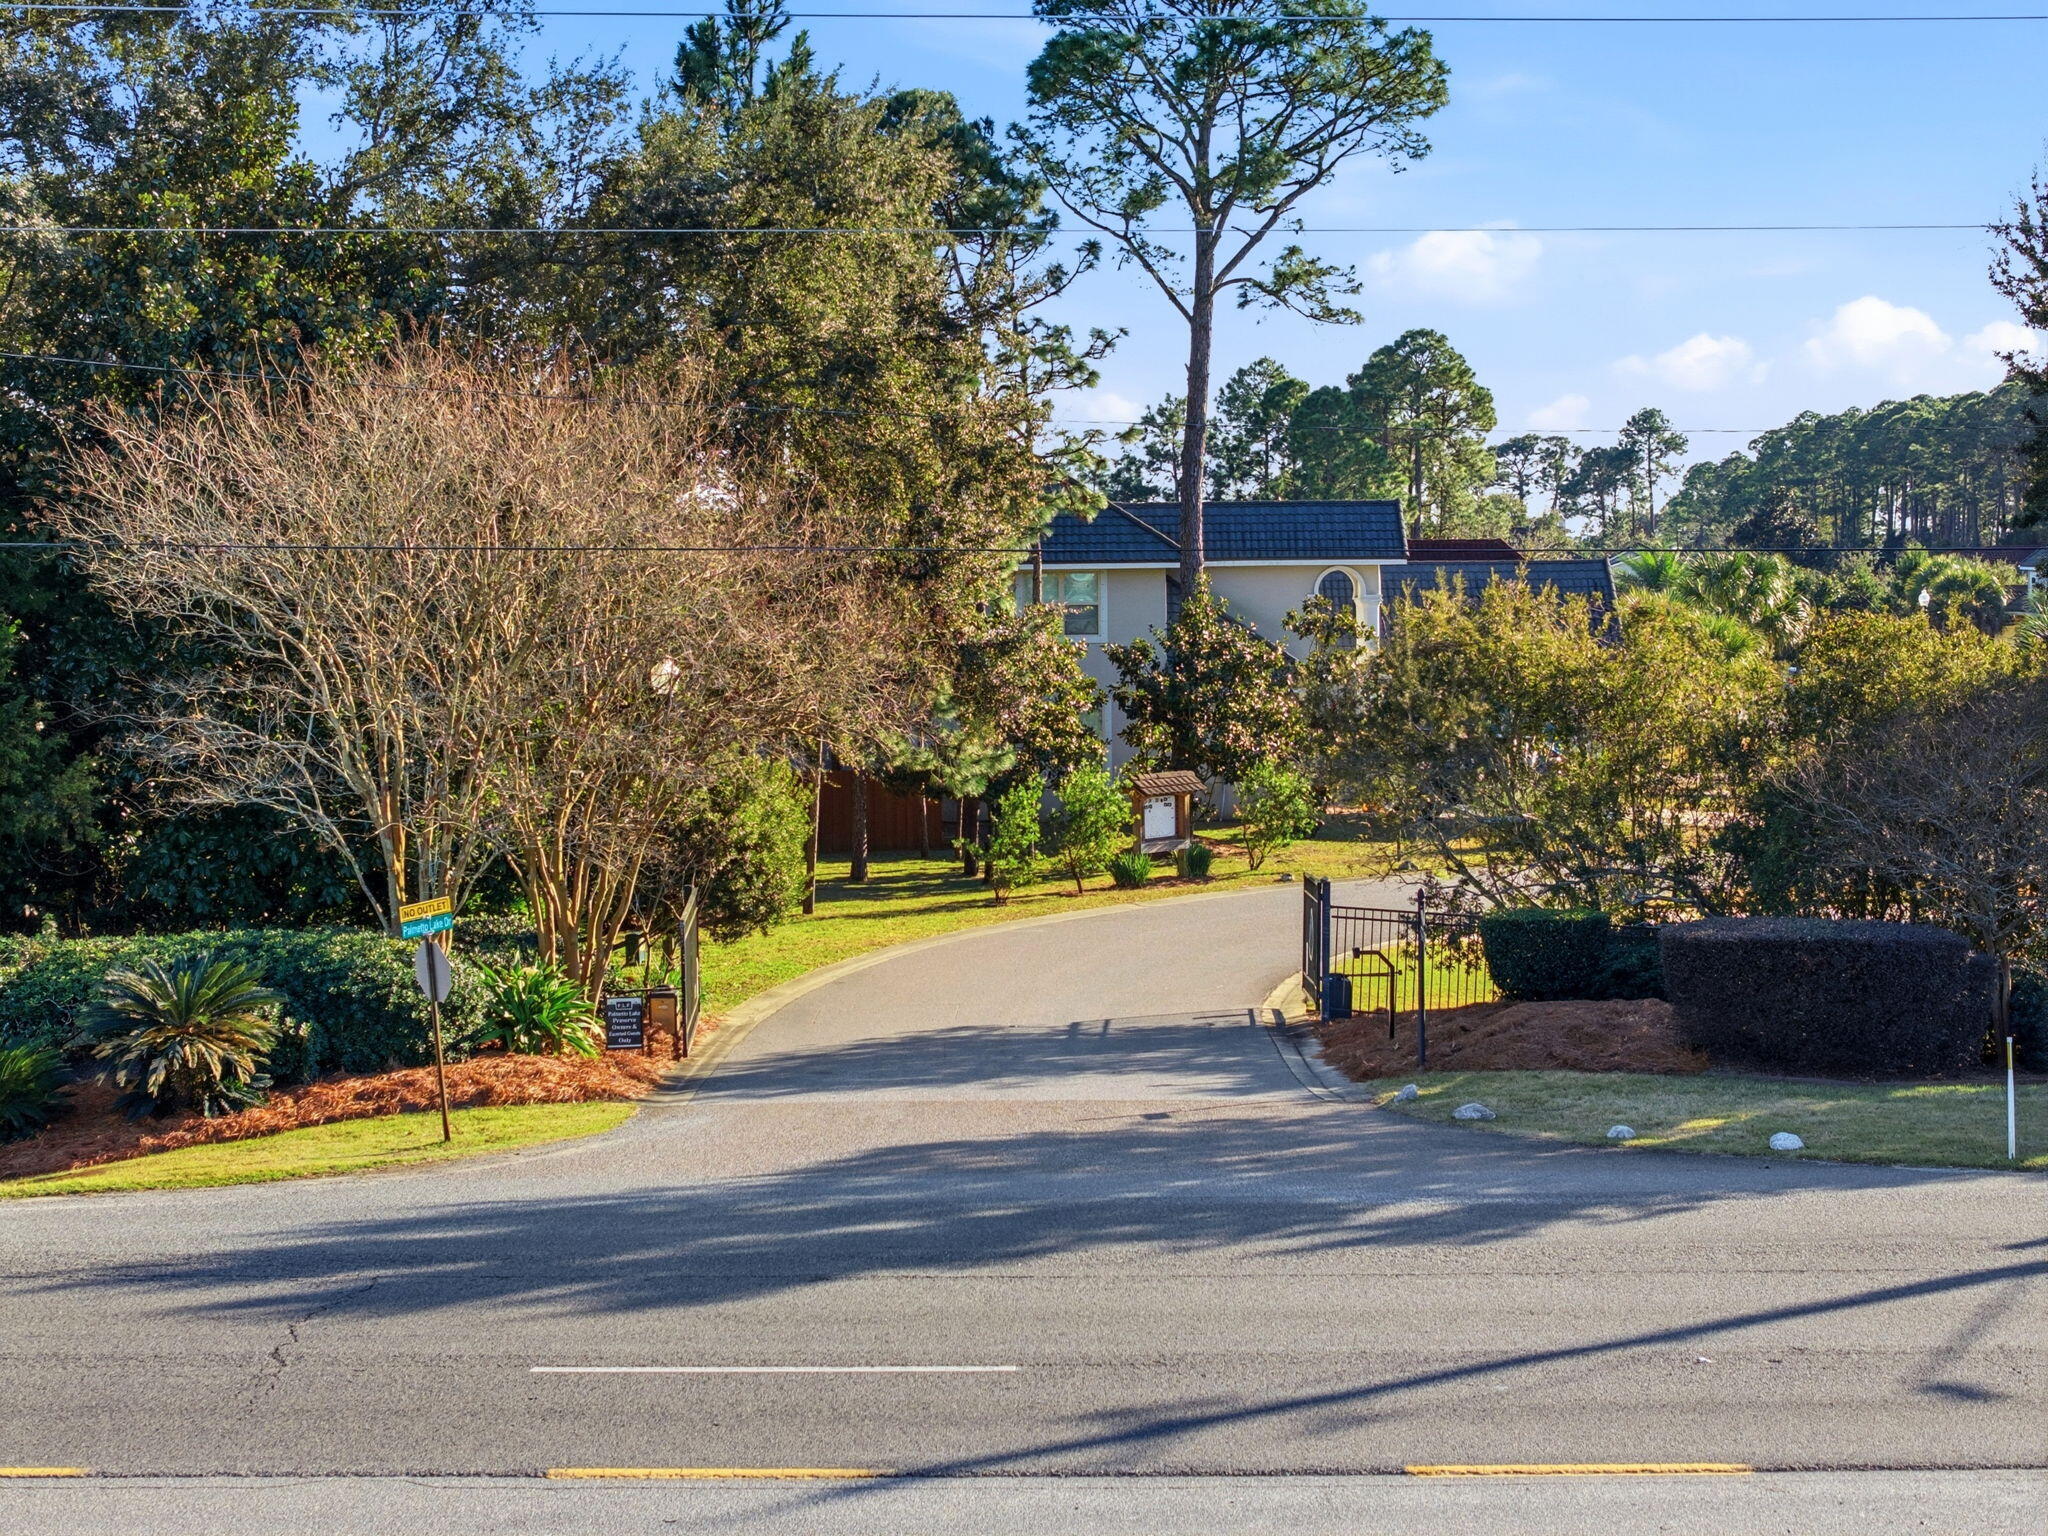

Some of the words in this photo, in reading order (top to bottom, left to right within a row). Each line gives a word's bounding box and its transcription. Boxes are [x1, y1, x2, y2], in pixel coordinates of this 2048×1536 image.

[403, 909, 415, 918] NO
[417, 902, 446, 915] OUTLET
[403, 923, 428, 937] Palmetto
[430, 919, 443, 931] Lake
[443, 916, 451, 926] Dr
